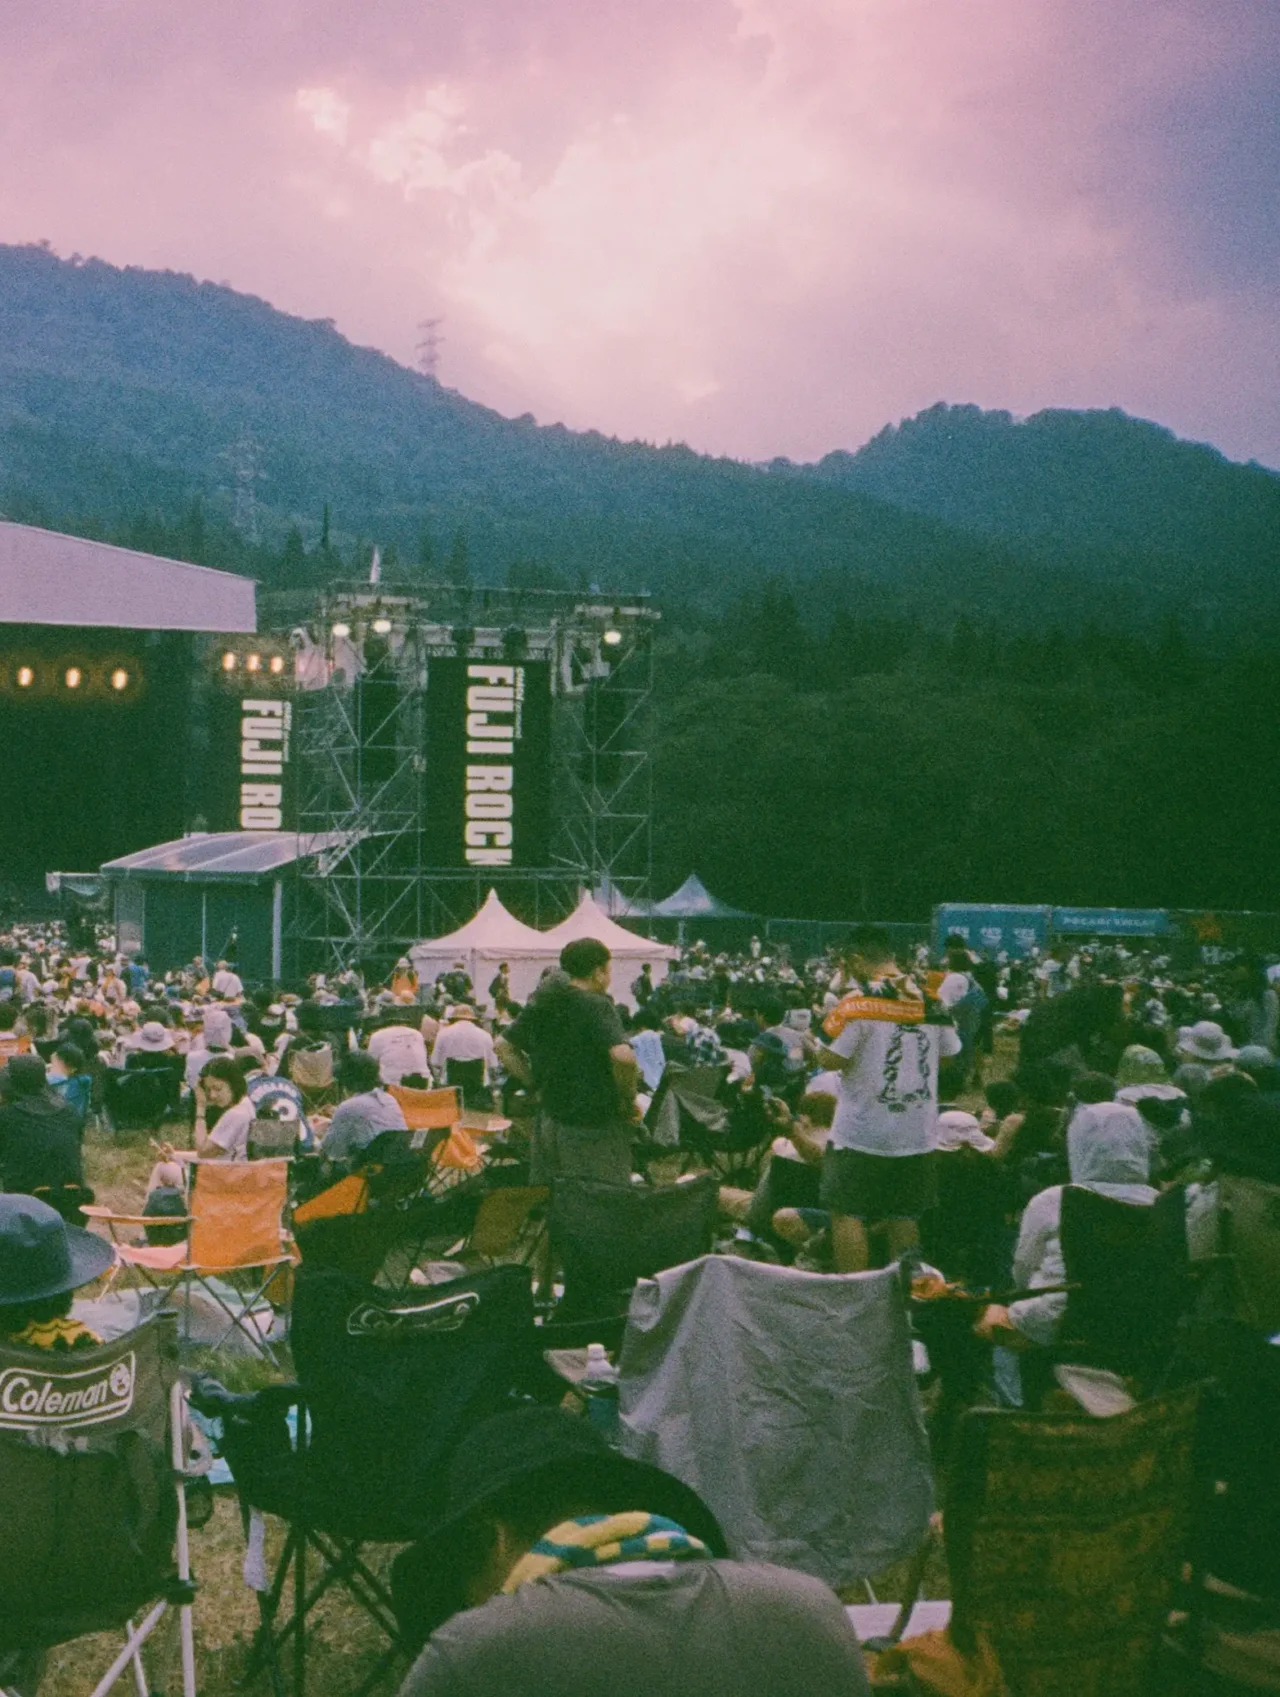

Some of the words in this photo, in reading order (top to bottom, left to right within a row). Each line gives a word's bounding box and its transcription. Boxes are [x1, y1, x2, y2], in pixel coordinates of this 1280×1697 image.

[241, 699, 282, 774] FUJI
[467, 665, 515, 754] FUJI
[465, 765, 513, 866] ROCK
[2, 1376, 108, 1414] Coleman
